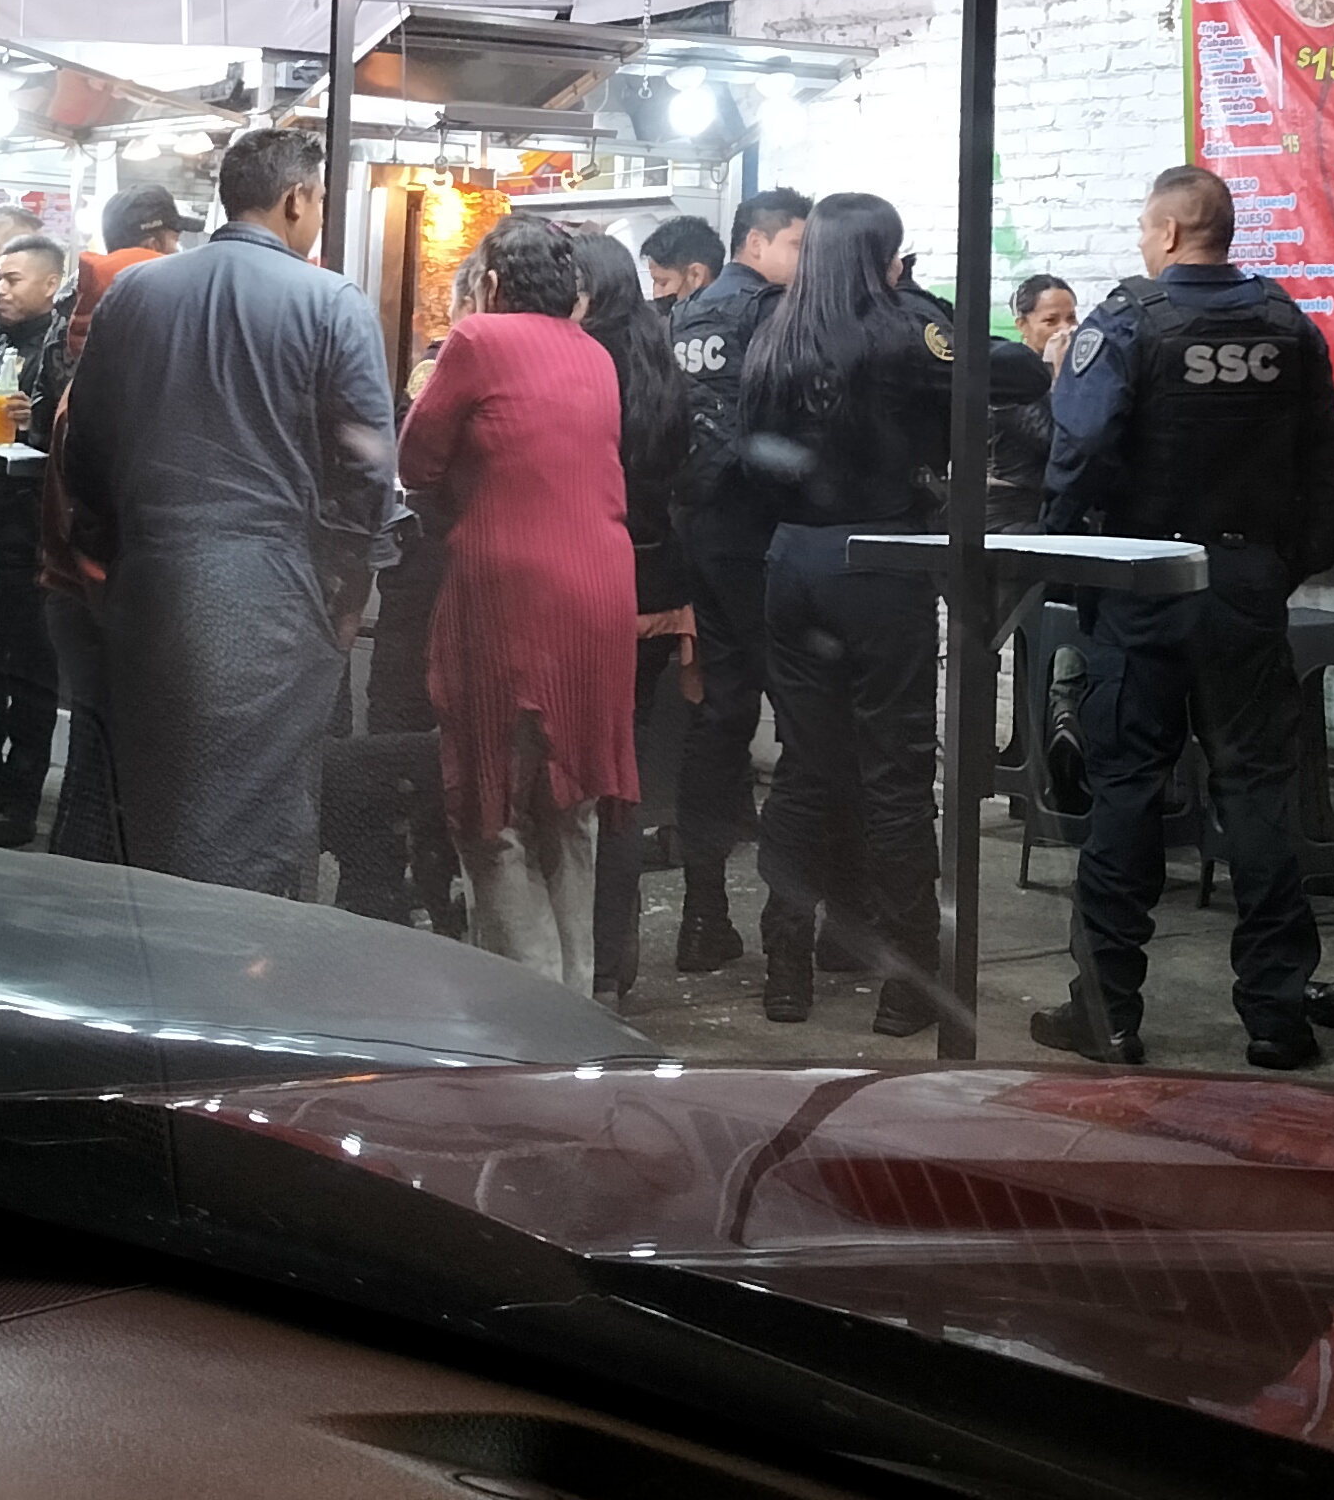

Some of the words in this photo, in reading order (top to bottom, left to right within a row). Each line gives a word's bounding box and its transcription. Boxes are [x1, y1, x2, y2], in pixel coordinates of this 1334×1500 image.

[1282, 134, 1300, 153] $15
[672, 334, 726, 373] SSC
[1183, 343, 1281, 384] SSC
